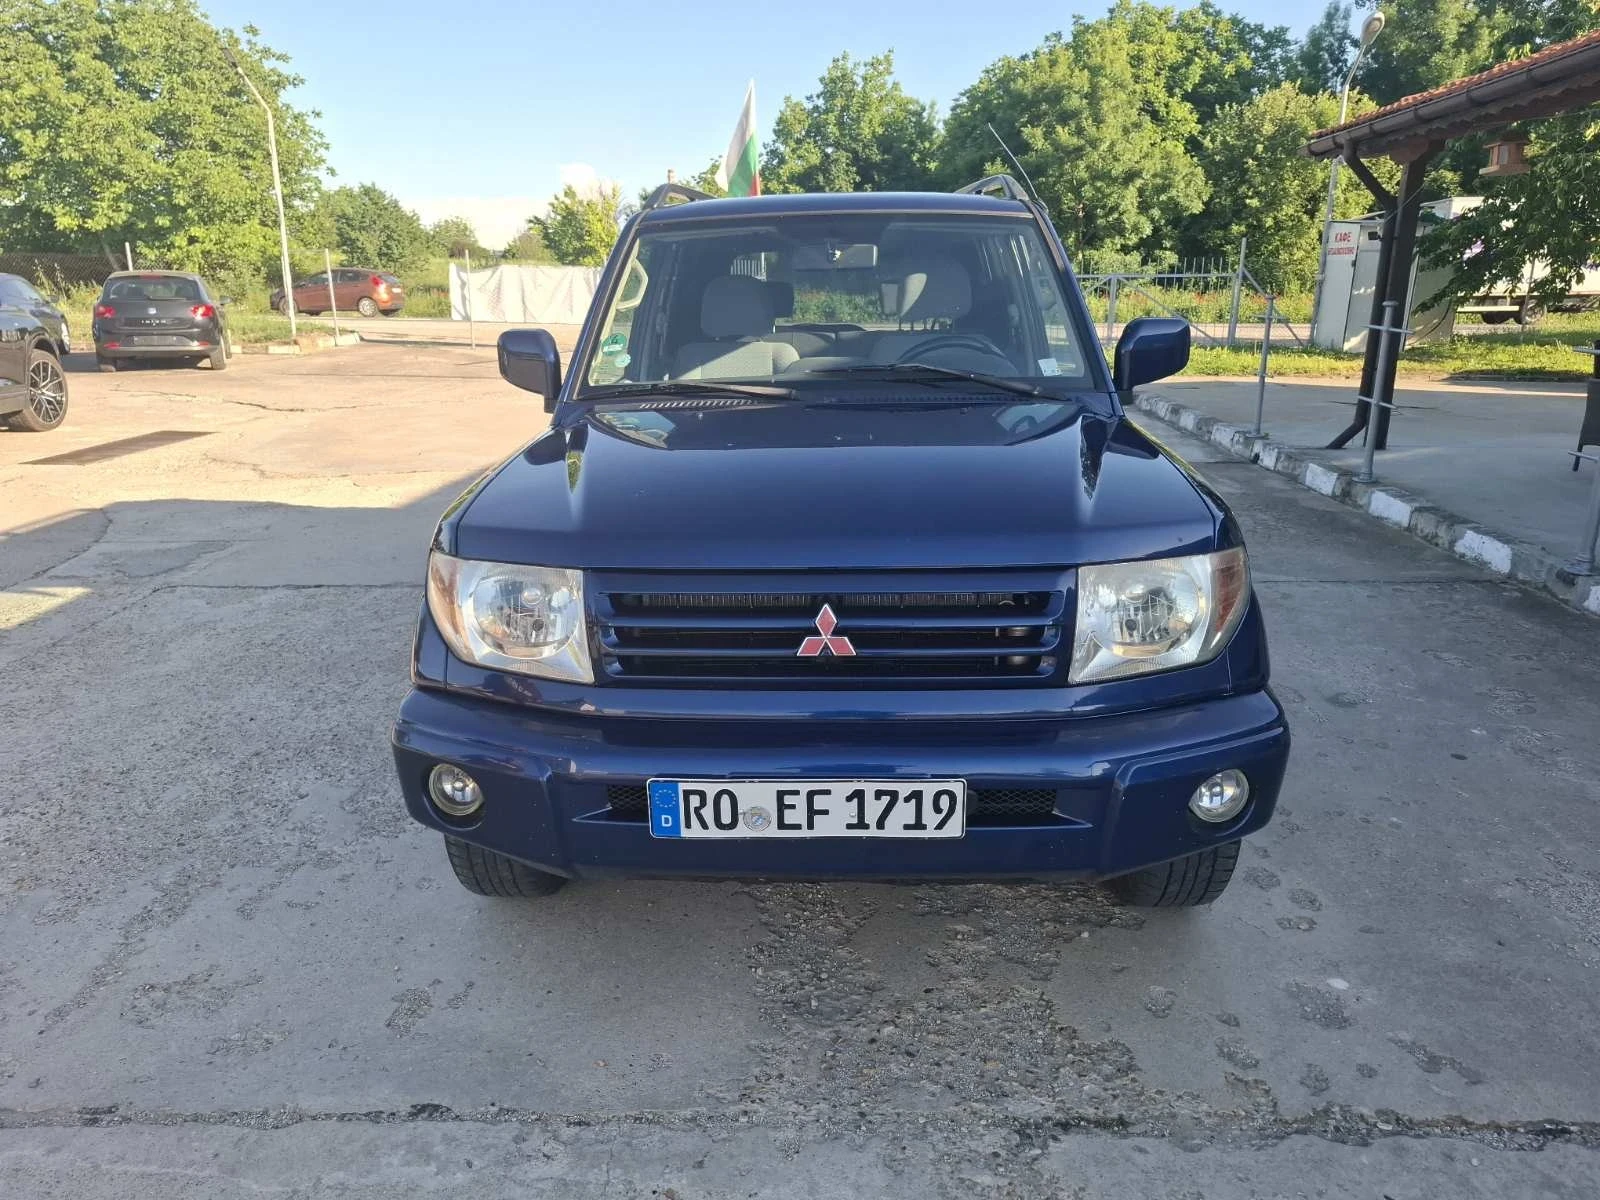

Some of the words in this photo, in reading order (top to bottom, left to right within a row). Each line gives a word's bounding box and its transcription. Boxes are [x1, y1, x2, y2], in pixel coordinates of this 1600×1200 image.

[661, 814, 673, 828] D
[682, 788, 740, 831] RO
[776, 788, 832, 831] EF
[845, 788, 958, 831] 1719
